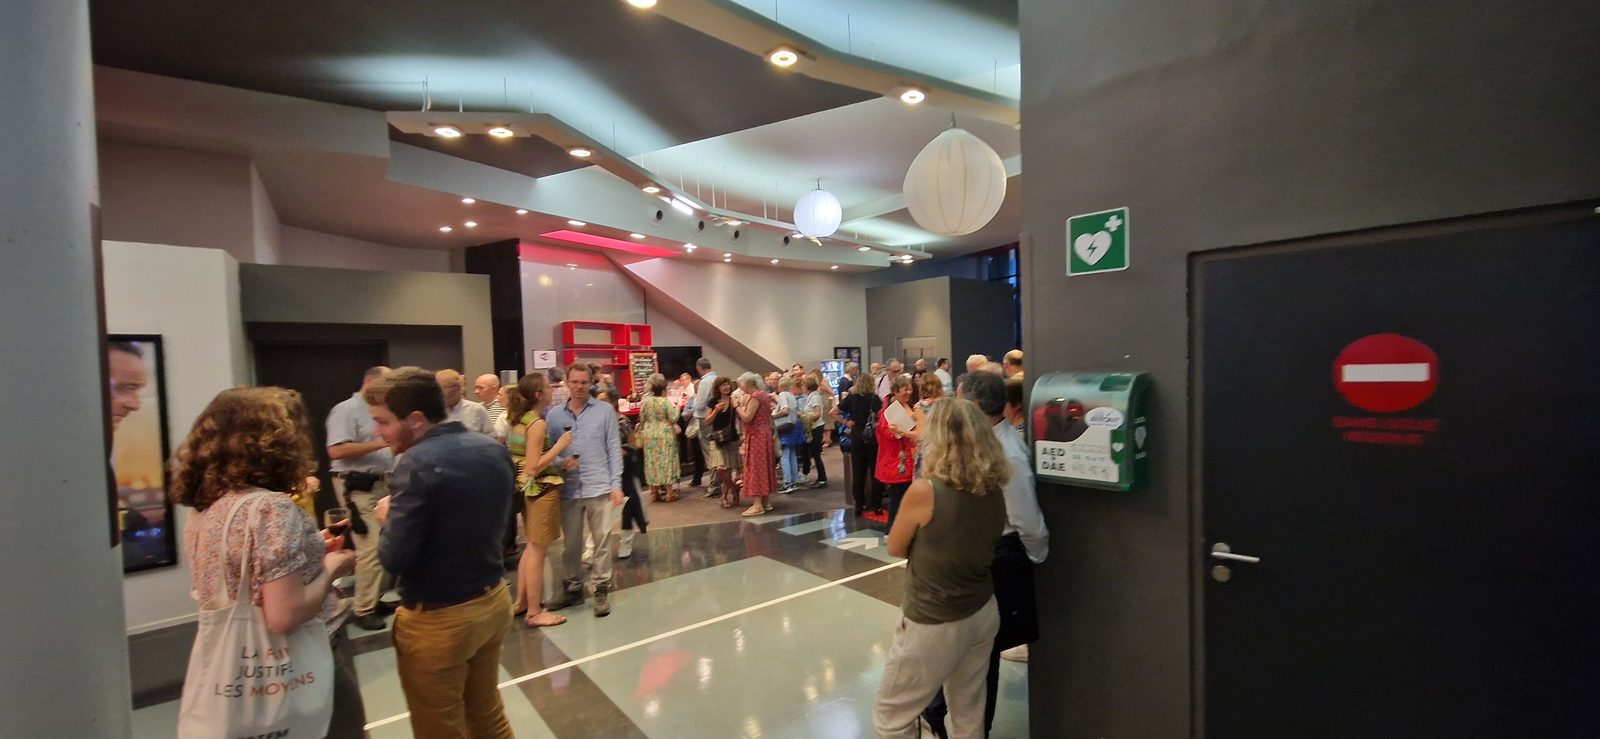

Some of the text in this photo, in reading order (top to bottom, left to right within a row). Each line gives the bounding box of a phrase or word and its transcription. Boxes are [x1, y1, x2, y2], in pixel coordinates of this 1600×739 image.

[1041, 447, 1066, 457] AED
[1041, 461, 1067, 472] DAE
[266, 647, 290, 661] FN
[236, 662, 294, 680] JUSTIFE
[215, 671, 315, 698] LES MOYENS
